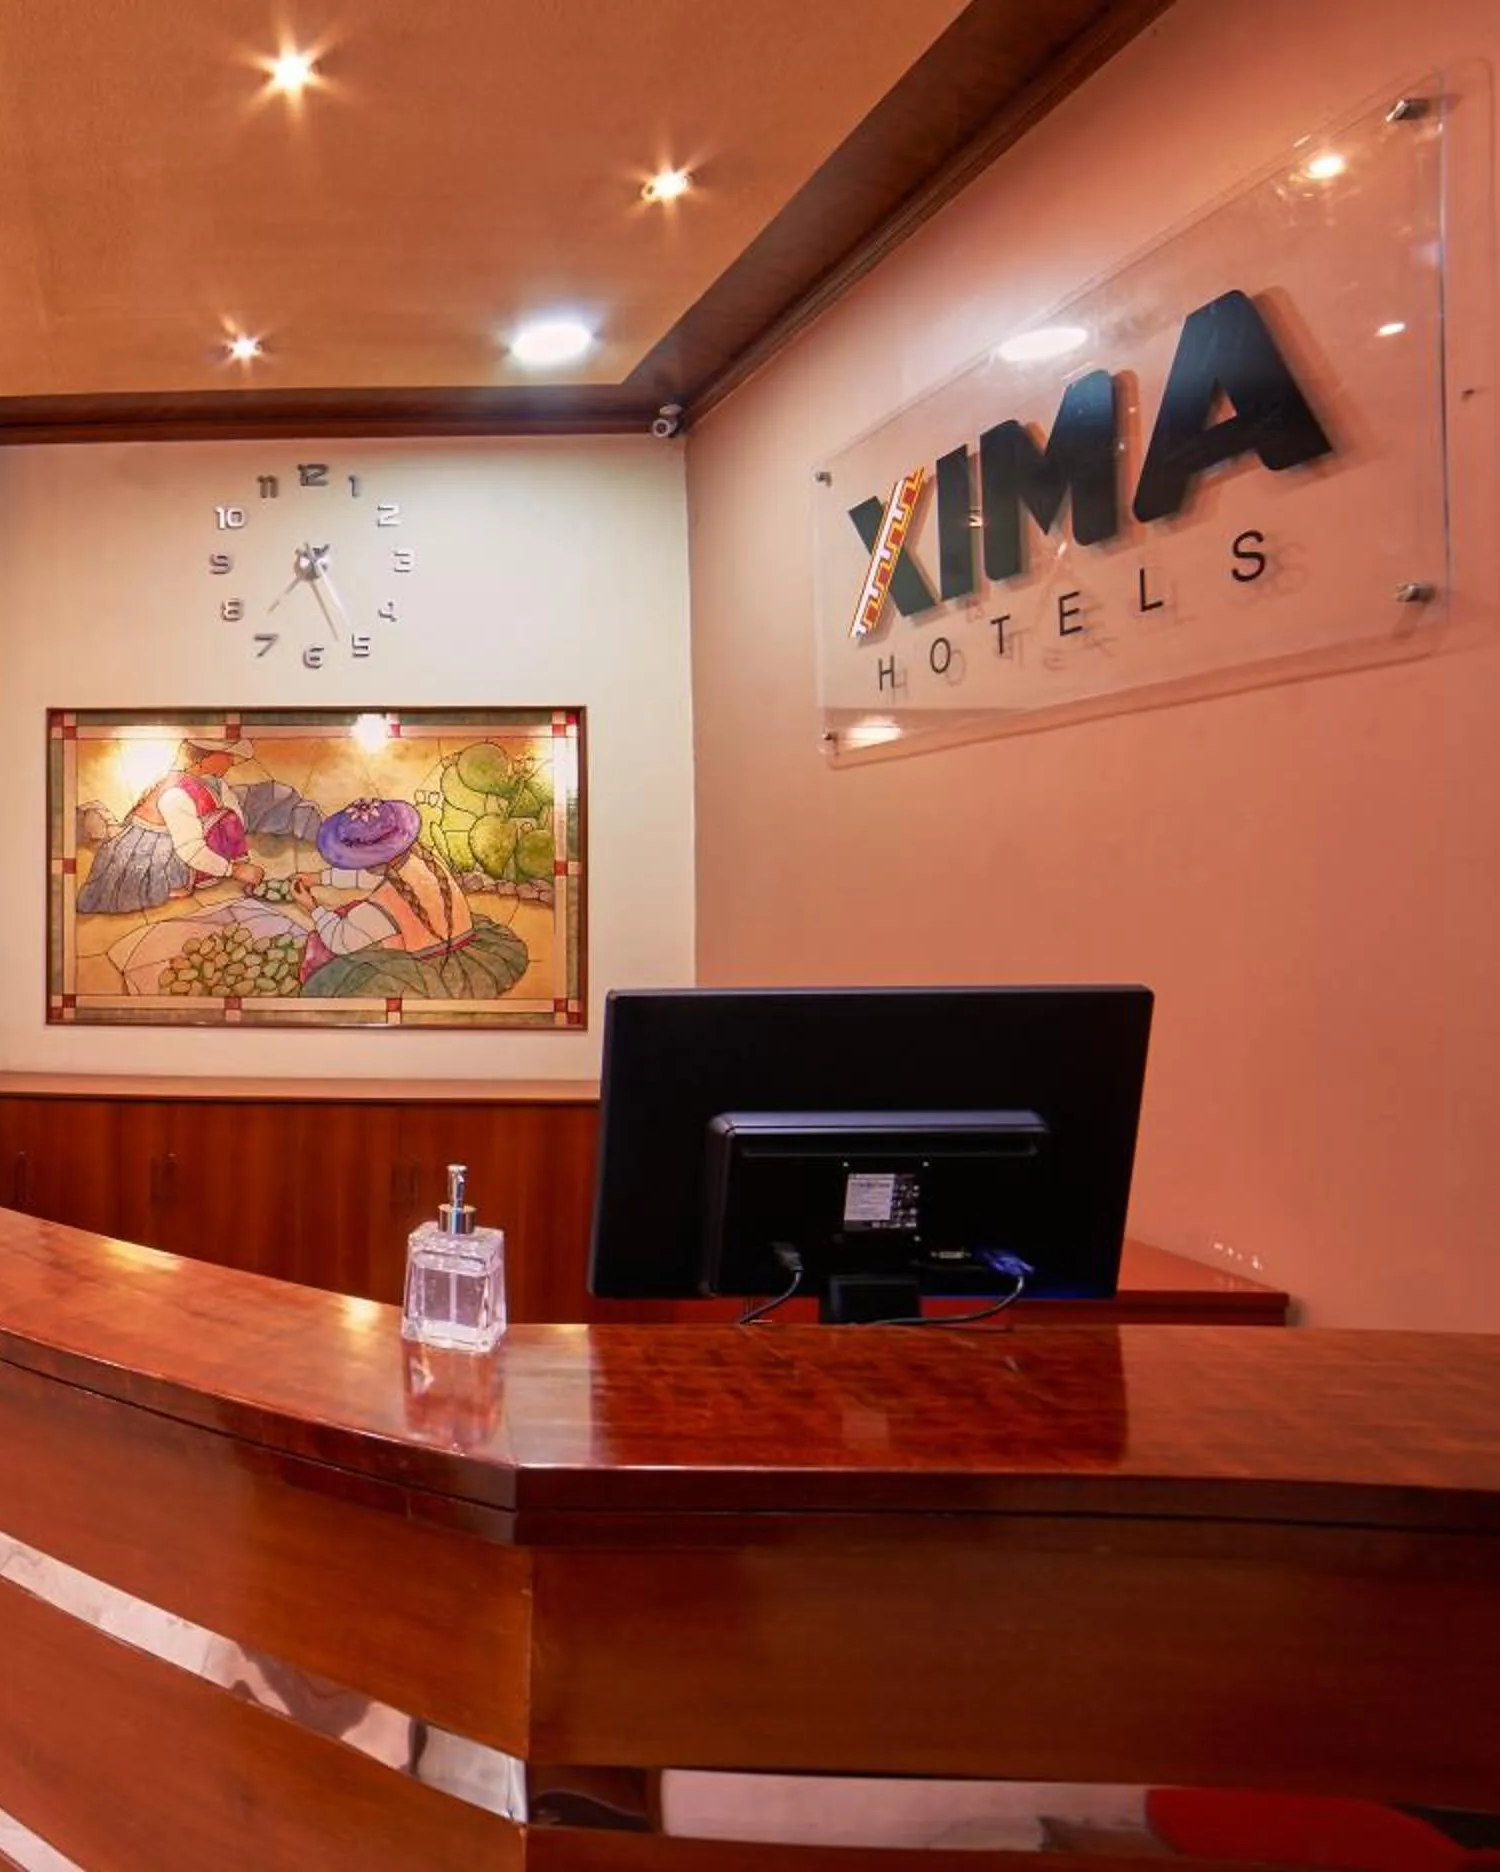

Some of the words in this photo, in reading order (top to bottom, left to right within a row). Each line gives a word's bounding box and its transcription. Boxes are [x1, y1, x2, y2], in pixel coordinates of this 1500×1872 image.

[298, 463, 329, 486] 12
[848, 288, 1334, 639] XIMA
[257, 474, 278, 498] 11
[349, 474, 361, 497] 1
[214, 506, 245, 529] 10
[376, 504, 402, 527] 2
[393, 549, 414, 574] 3
[221, 598, 244, 621] 8
[876, 529, 1267, 692] HOTELS
[253, 633, 279, 659] 7
[303, 645, 325, 669] 6
[350, 632, 372, 659] 5
